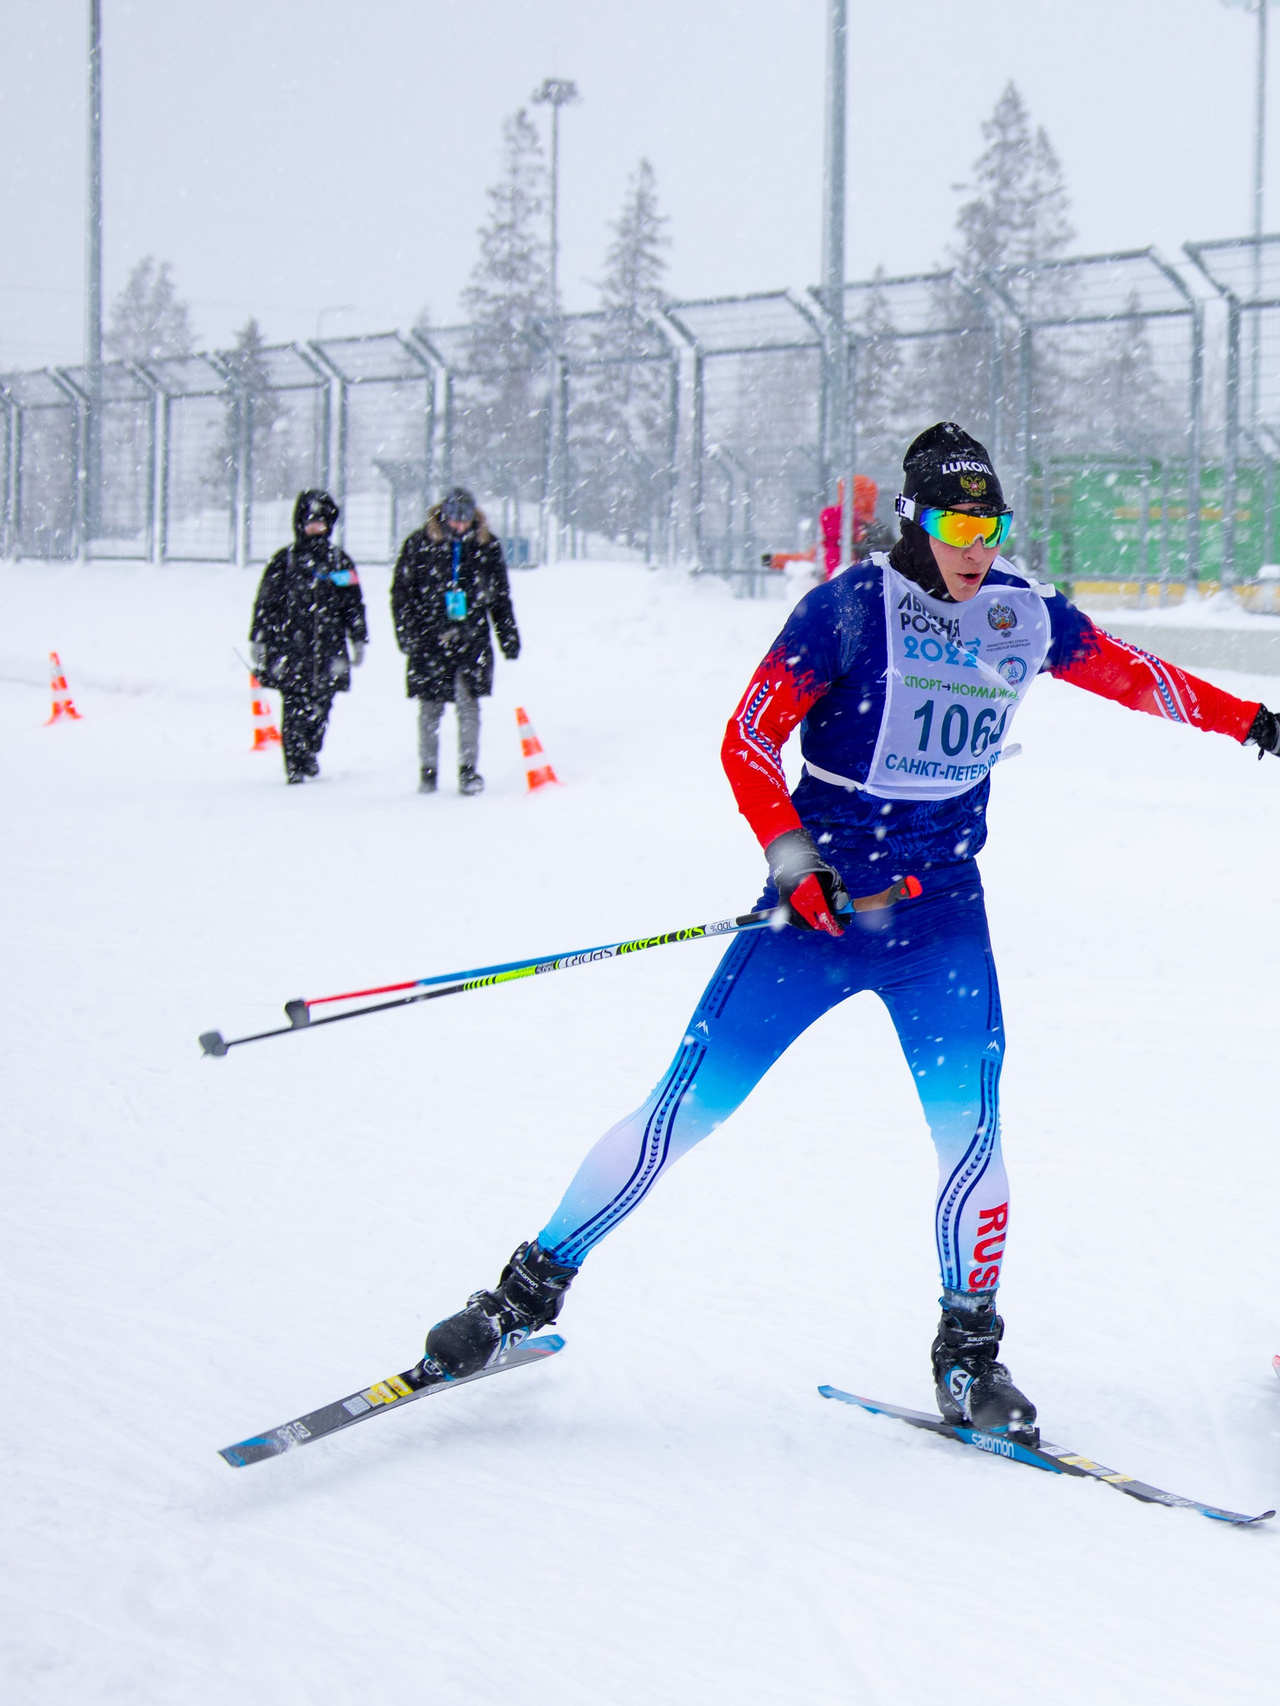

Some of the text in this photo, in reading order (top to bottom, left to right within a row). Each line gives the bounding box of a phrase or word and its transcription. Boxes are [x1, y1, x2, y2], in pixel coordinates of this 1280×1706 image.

[941, 461, 993, 476] LUKOIL
[903, 635, 979, 669] 2022
[904, 675, 942, 692] СПОРТ
[951, 682, 997, 699] НОРМА
[913, 700, 1012, 757] 1064
[967, 1202, 1008, 1292] RUS
[966, 1335, 995, 1343] salomon
[971, 1432, 1015, 1458] salomon
